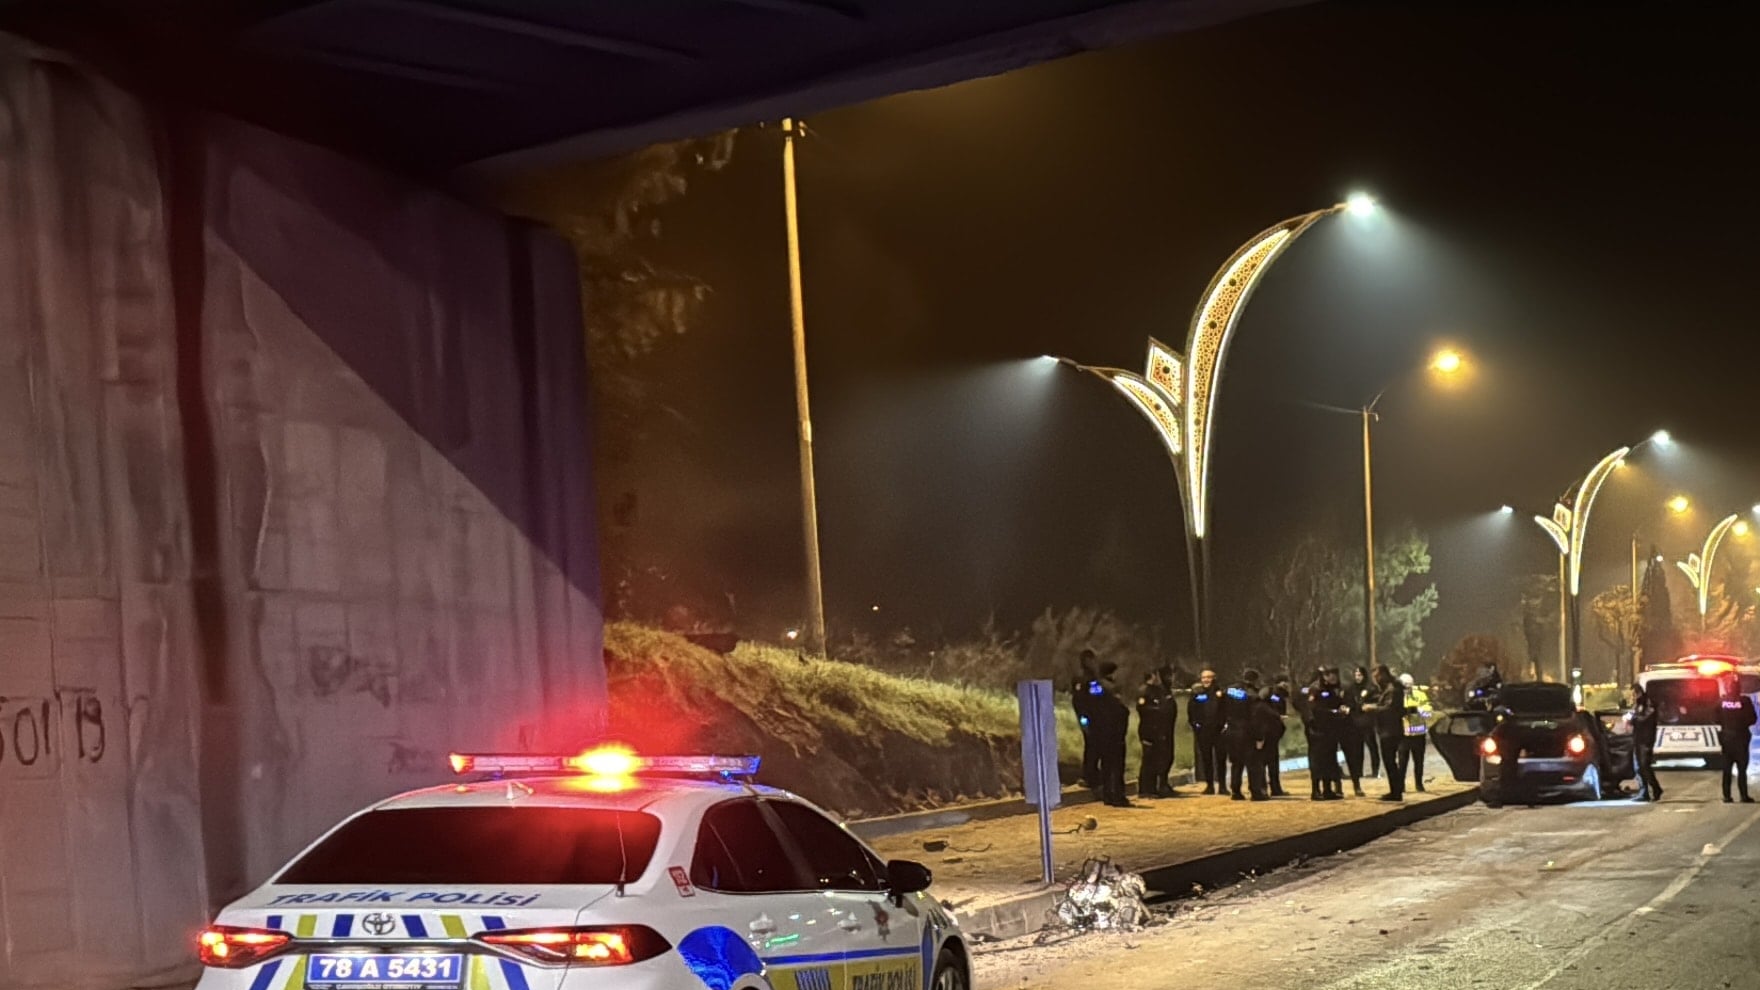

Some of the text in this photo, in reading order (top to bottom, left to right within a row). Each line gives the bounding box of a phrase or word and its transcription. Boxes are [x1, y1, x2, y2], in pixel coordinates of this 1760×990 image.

[268, 890, 541, 906] TRAFİK POLİSİ
[319, 959, 451, 978] 78 A 5431
